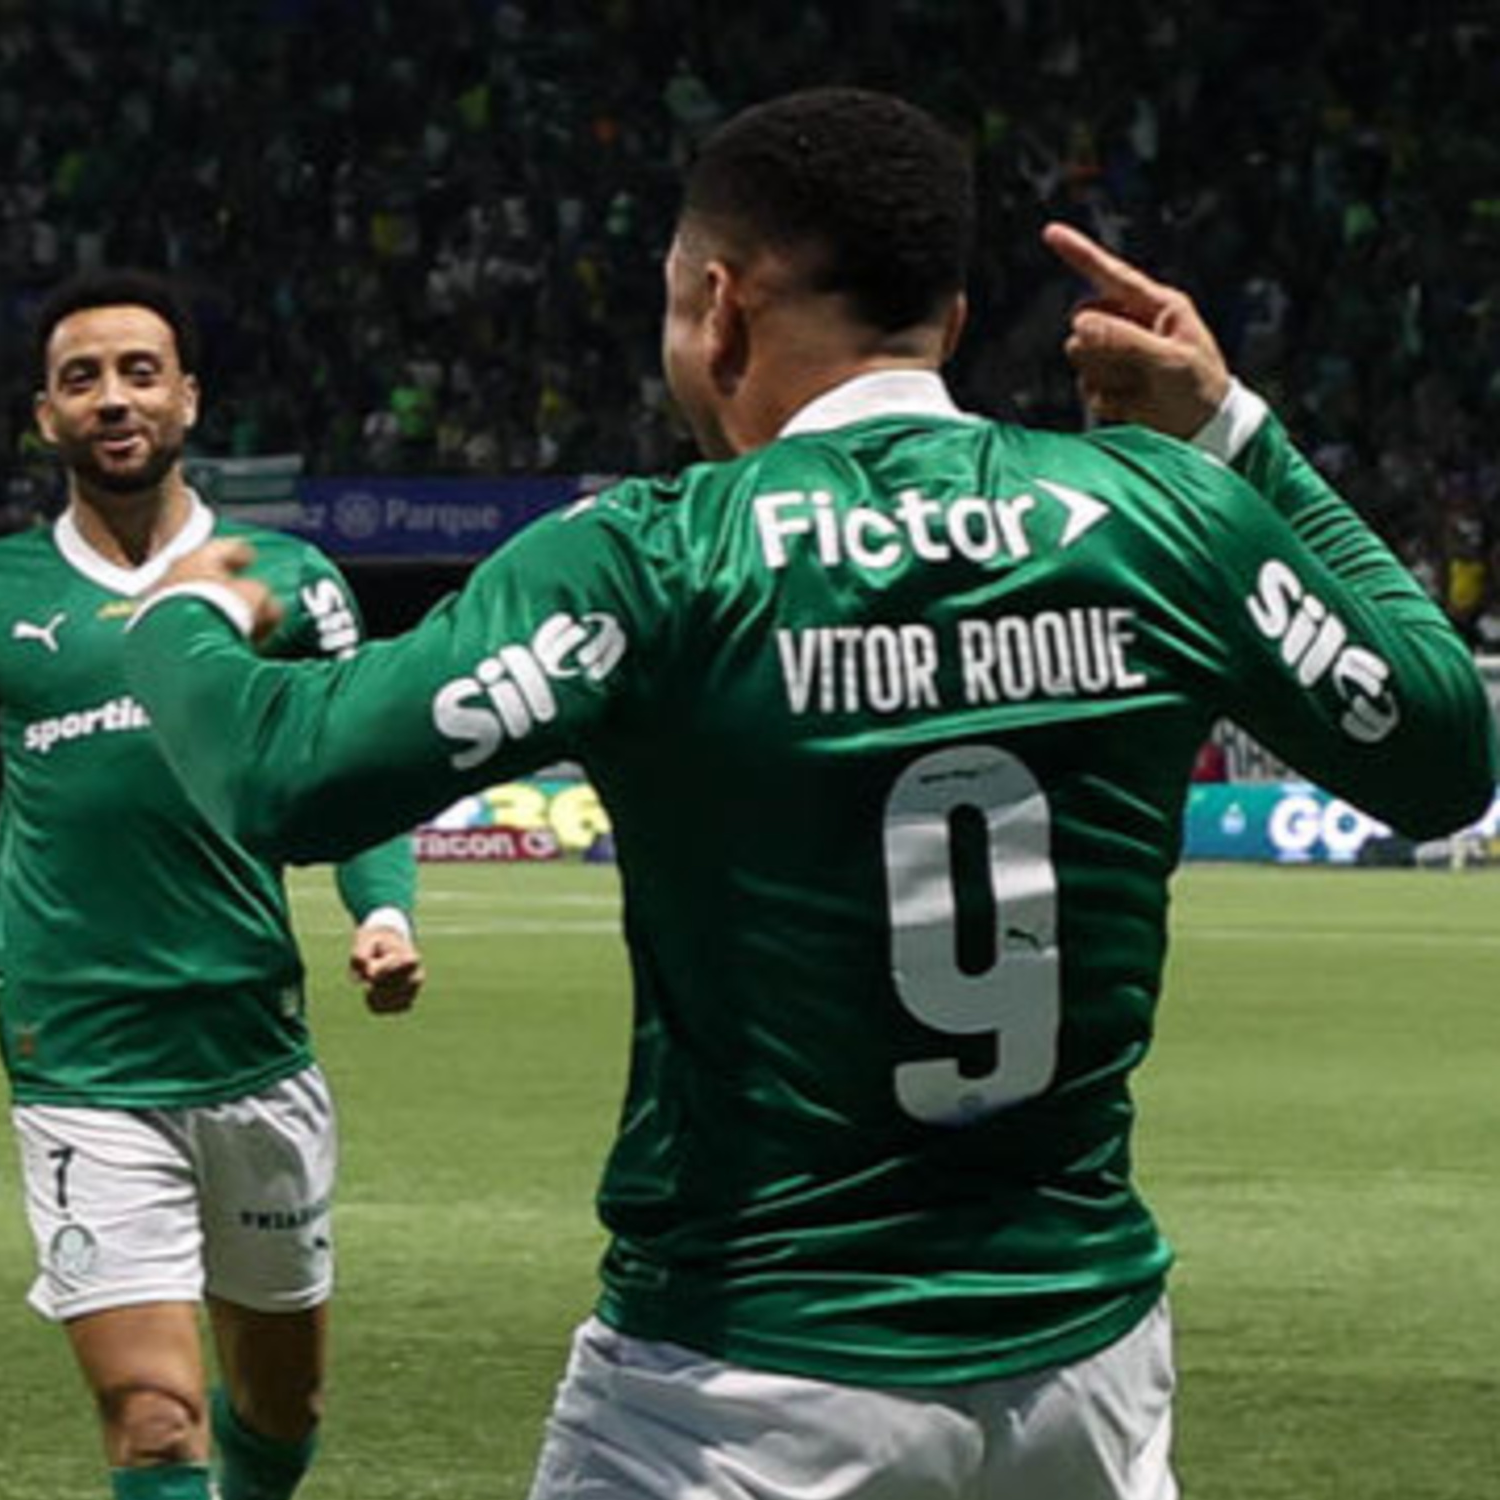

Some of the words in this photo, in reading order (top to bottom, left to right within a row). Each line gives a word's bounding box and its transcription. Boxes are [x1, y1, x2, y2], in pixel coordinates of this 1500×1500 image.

[386, 501, 498, 535] Parque
[753, 489, 1035, 569] Fictor
[775, 624, 941, 714] VITOR
[957, 607, 1148, 704] ROQUE
[884, 744, 1060, 1125] 9
